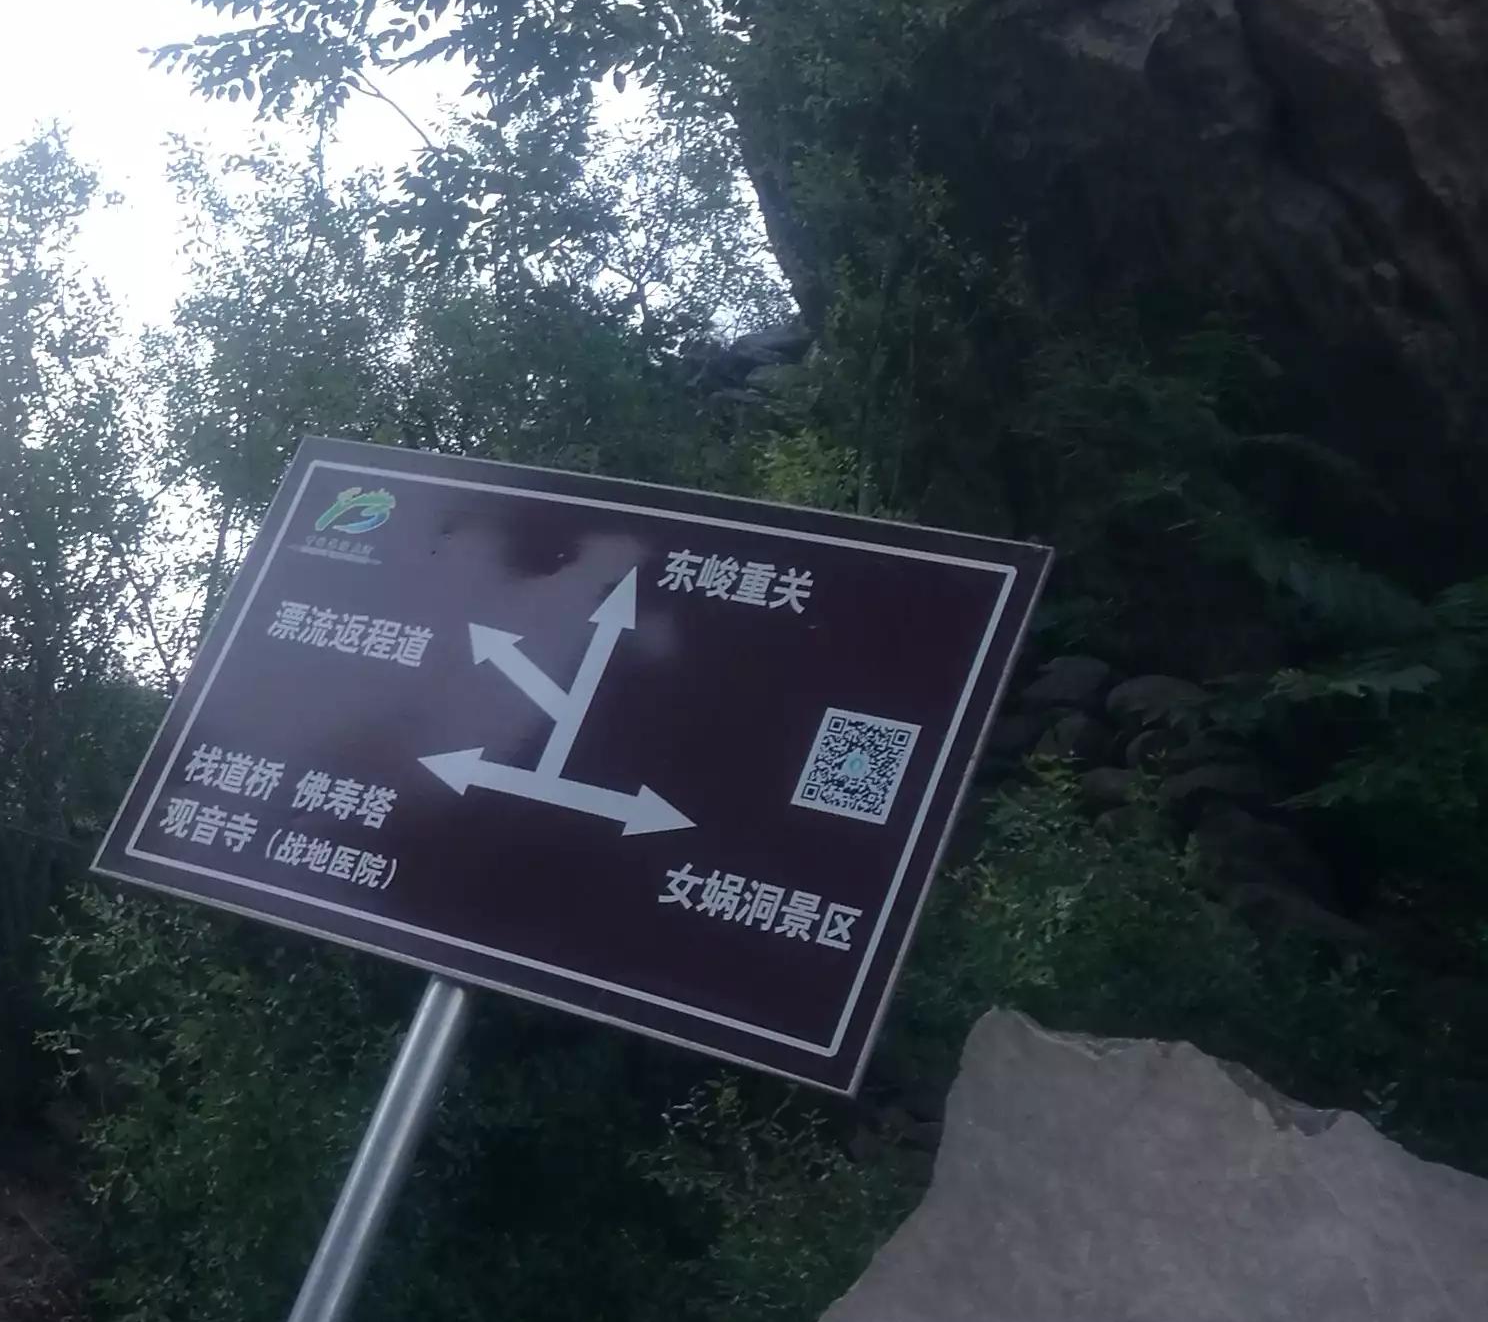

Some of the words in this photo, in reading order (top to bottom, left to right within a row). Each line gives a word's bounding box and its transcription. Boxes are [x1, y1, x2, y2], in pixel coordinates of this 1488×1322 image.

[657, 549, 813, 614] 东峻重关
[267, 600, 434, 667] 漂流返程道
[658, 862, 863, 951] 女娲洞景区
